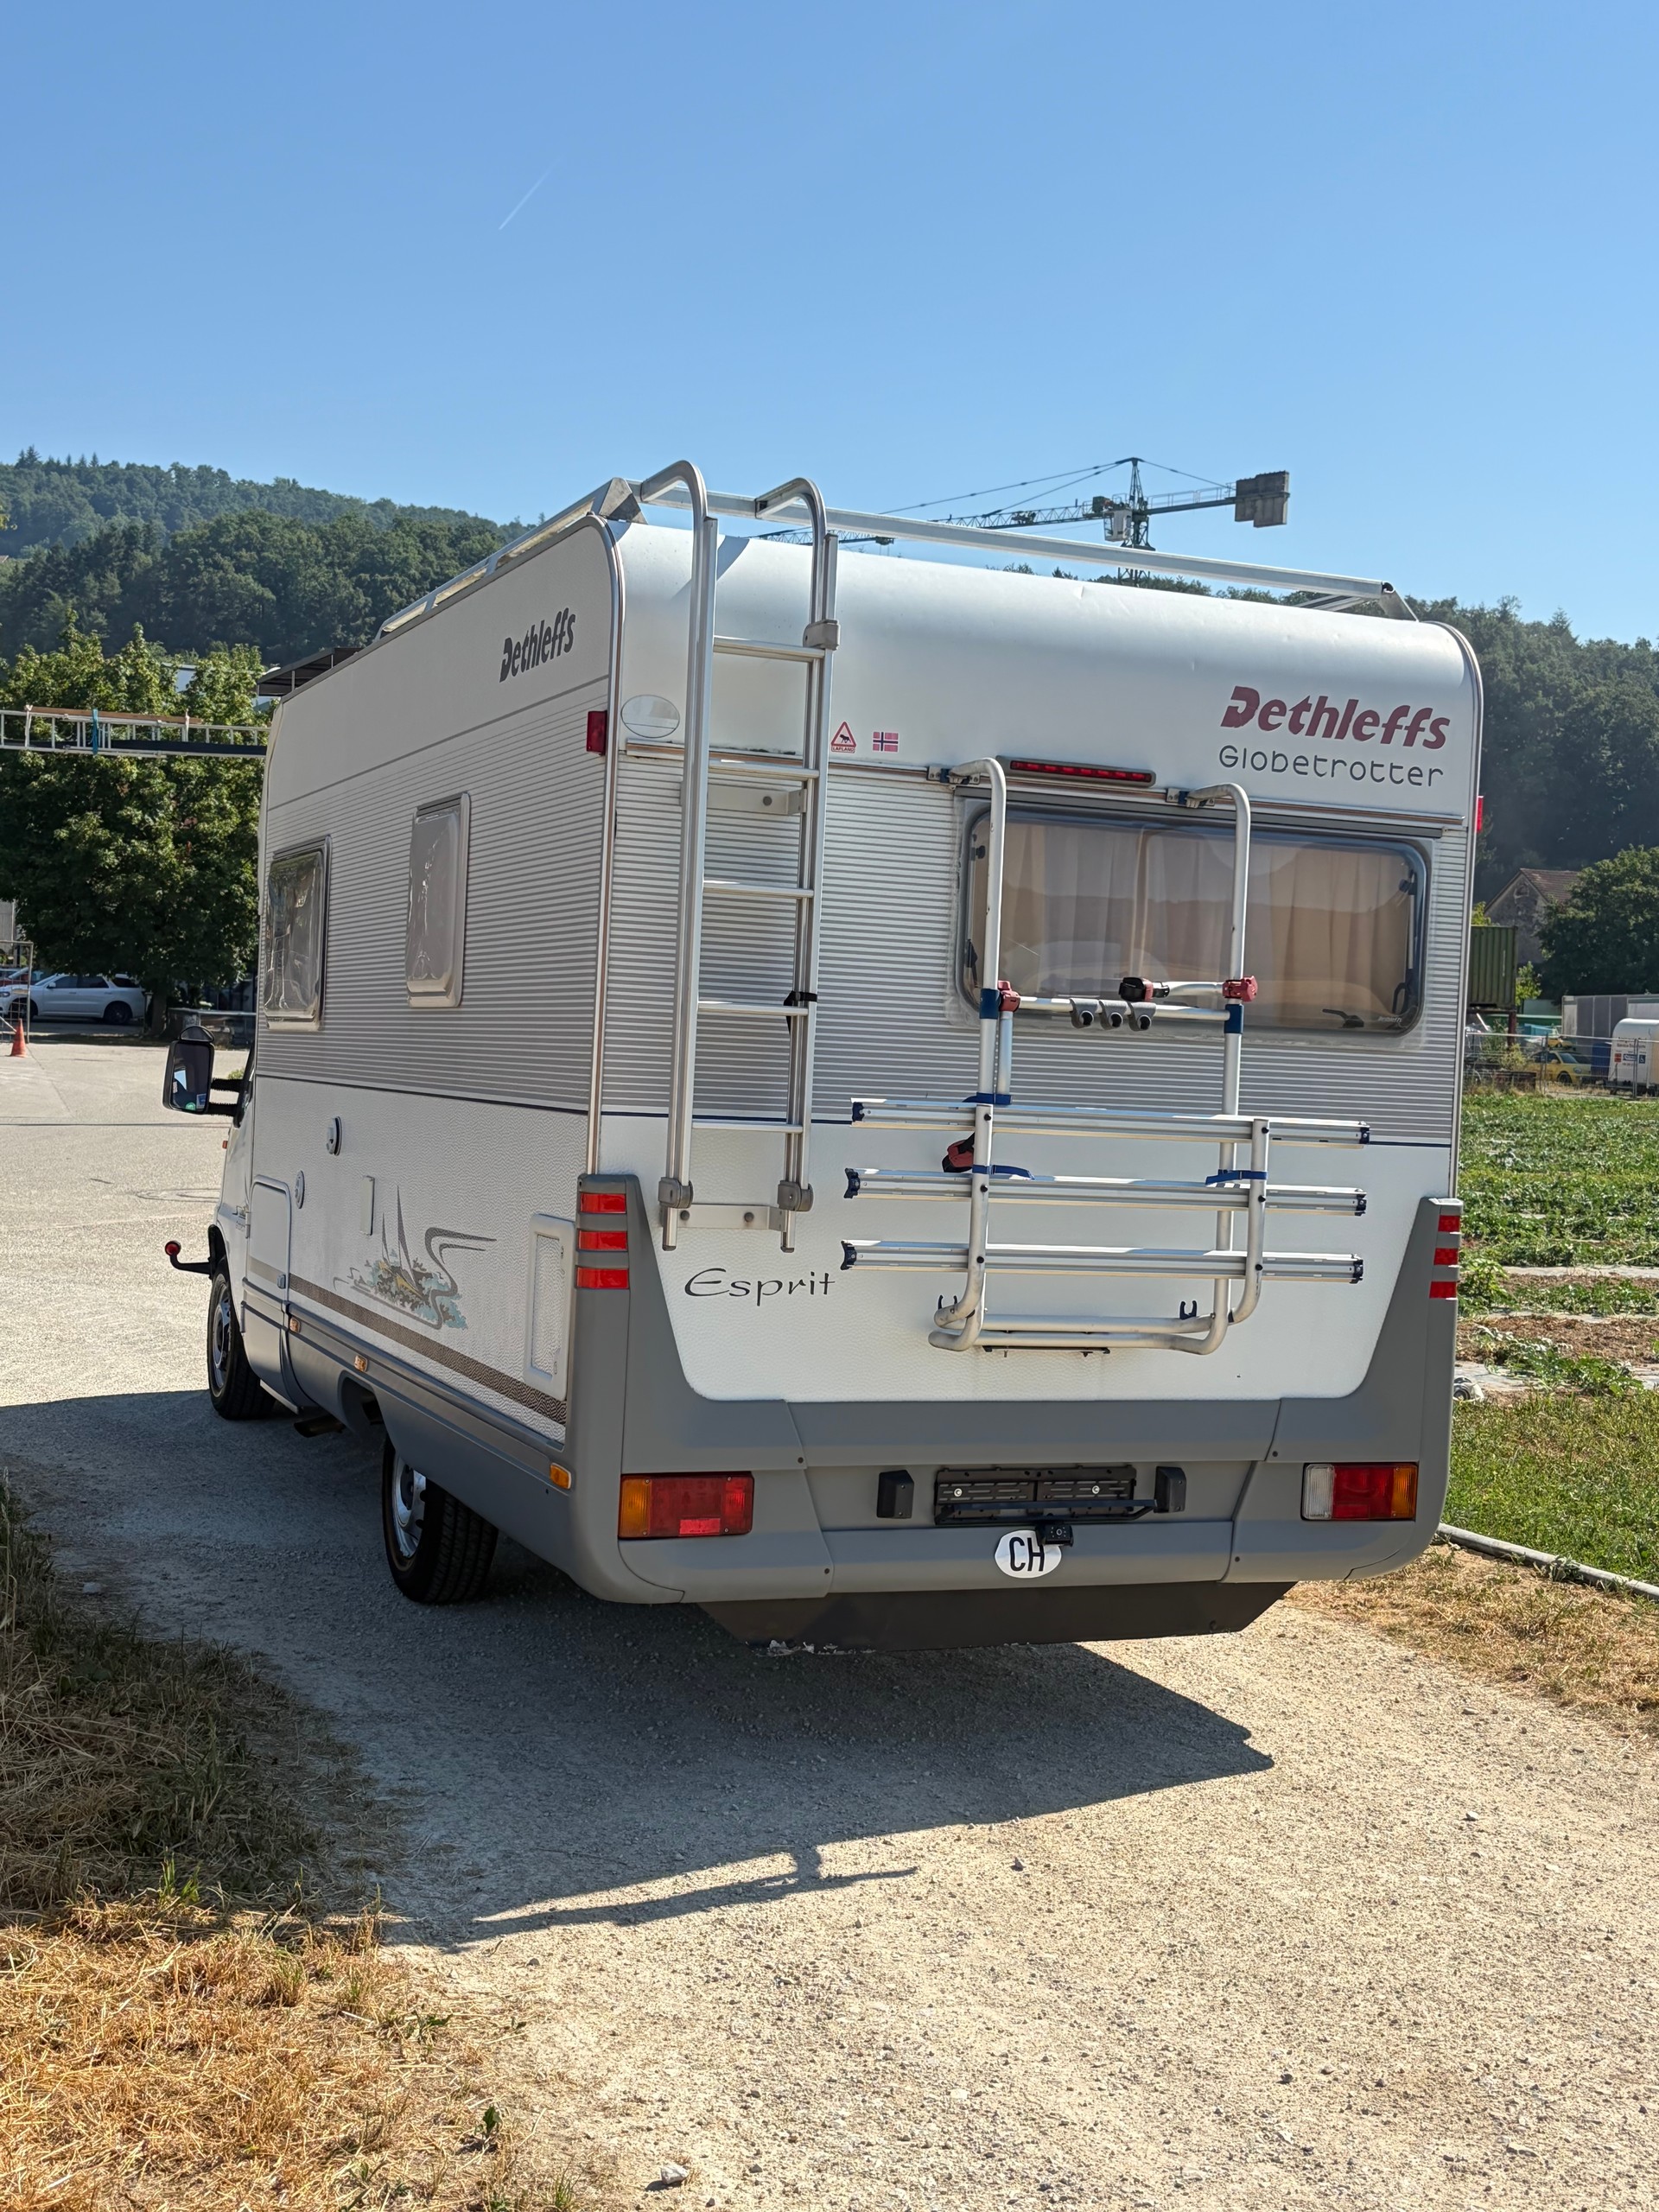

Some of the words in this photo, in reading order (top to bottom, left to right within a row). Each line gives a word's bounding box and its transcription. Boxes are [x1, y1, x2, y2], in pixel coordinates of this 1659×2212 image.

[499, 607, 576, 683] Dethleffs
[1220, 685, 1451, 750] Dethleffs
[1219, 745, 1444, 787] Globetrotter
[684, 1268, 836, 1306] Esprit
[1009, 1536, 1046, 1572] CH
